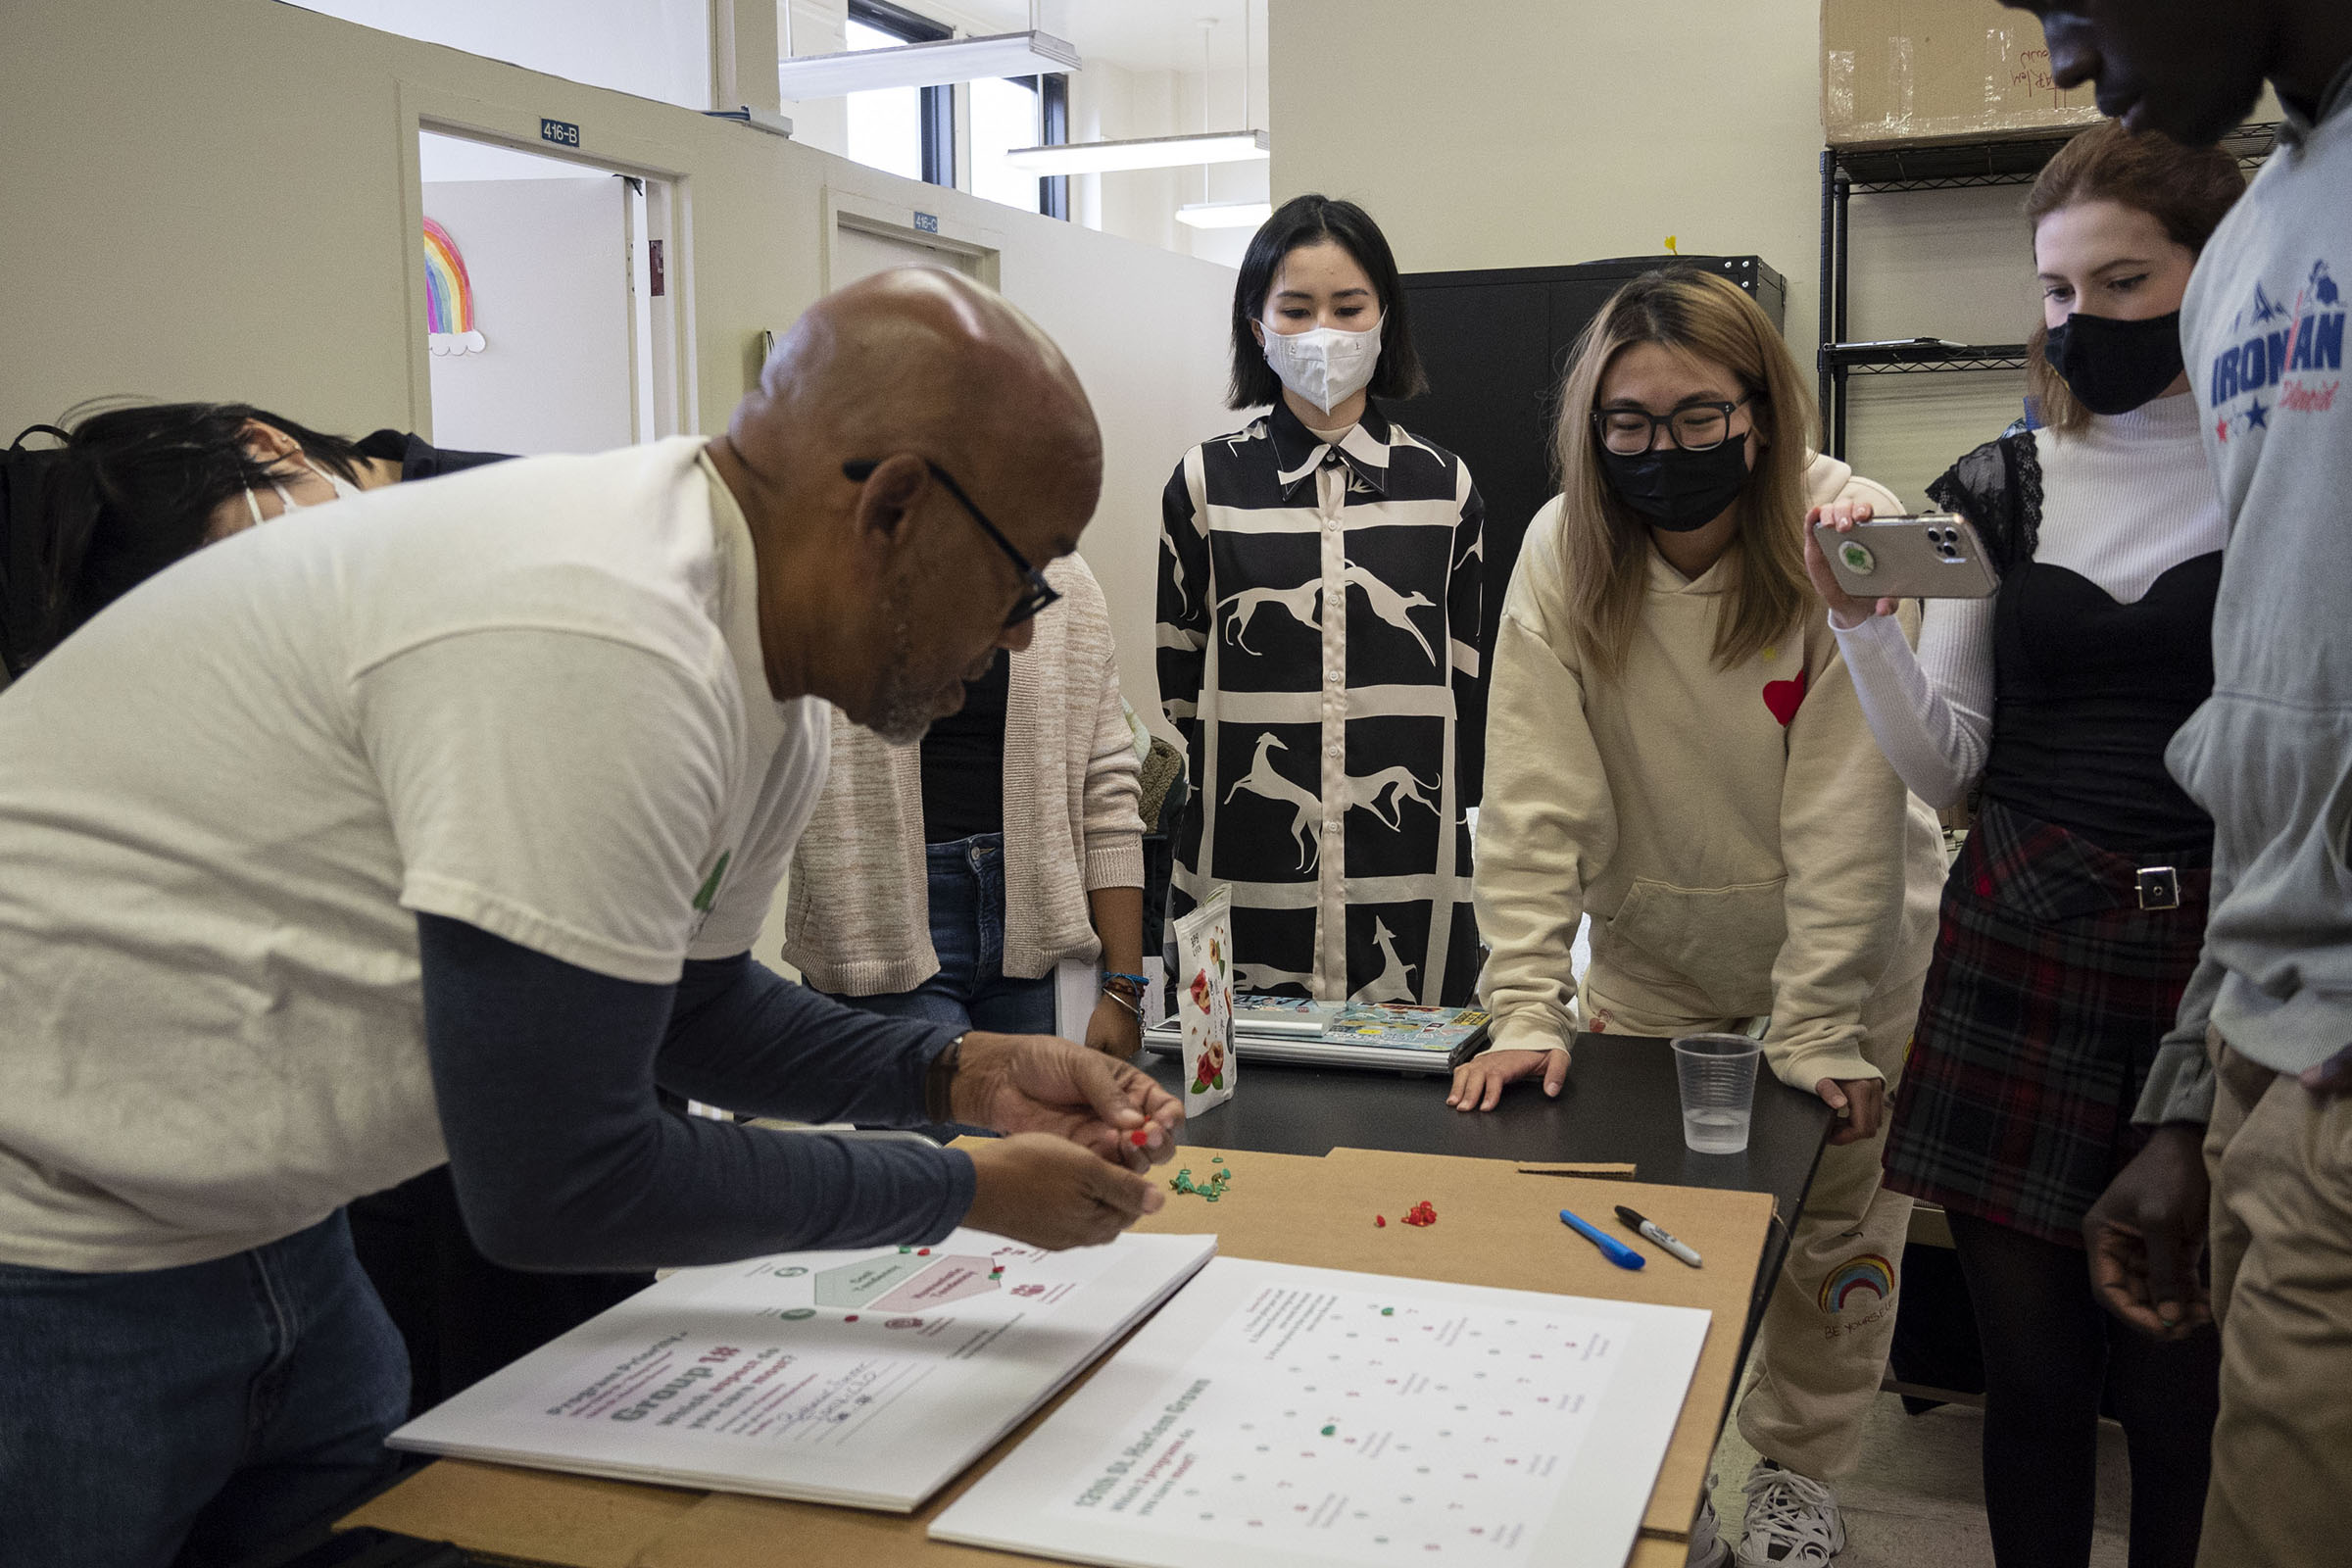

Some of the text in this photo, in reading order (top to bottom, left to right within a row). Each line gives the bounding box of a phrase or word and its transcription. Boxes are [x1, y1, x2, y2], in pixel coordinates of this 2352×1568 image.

[543, 122, 578, 144] 416-B
[915, 214, 938, 232] 416-C
[1825, 1325, 1841, 1340] BE
[610, 1367, 713, 1422] Group
